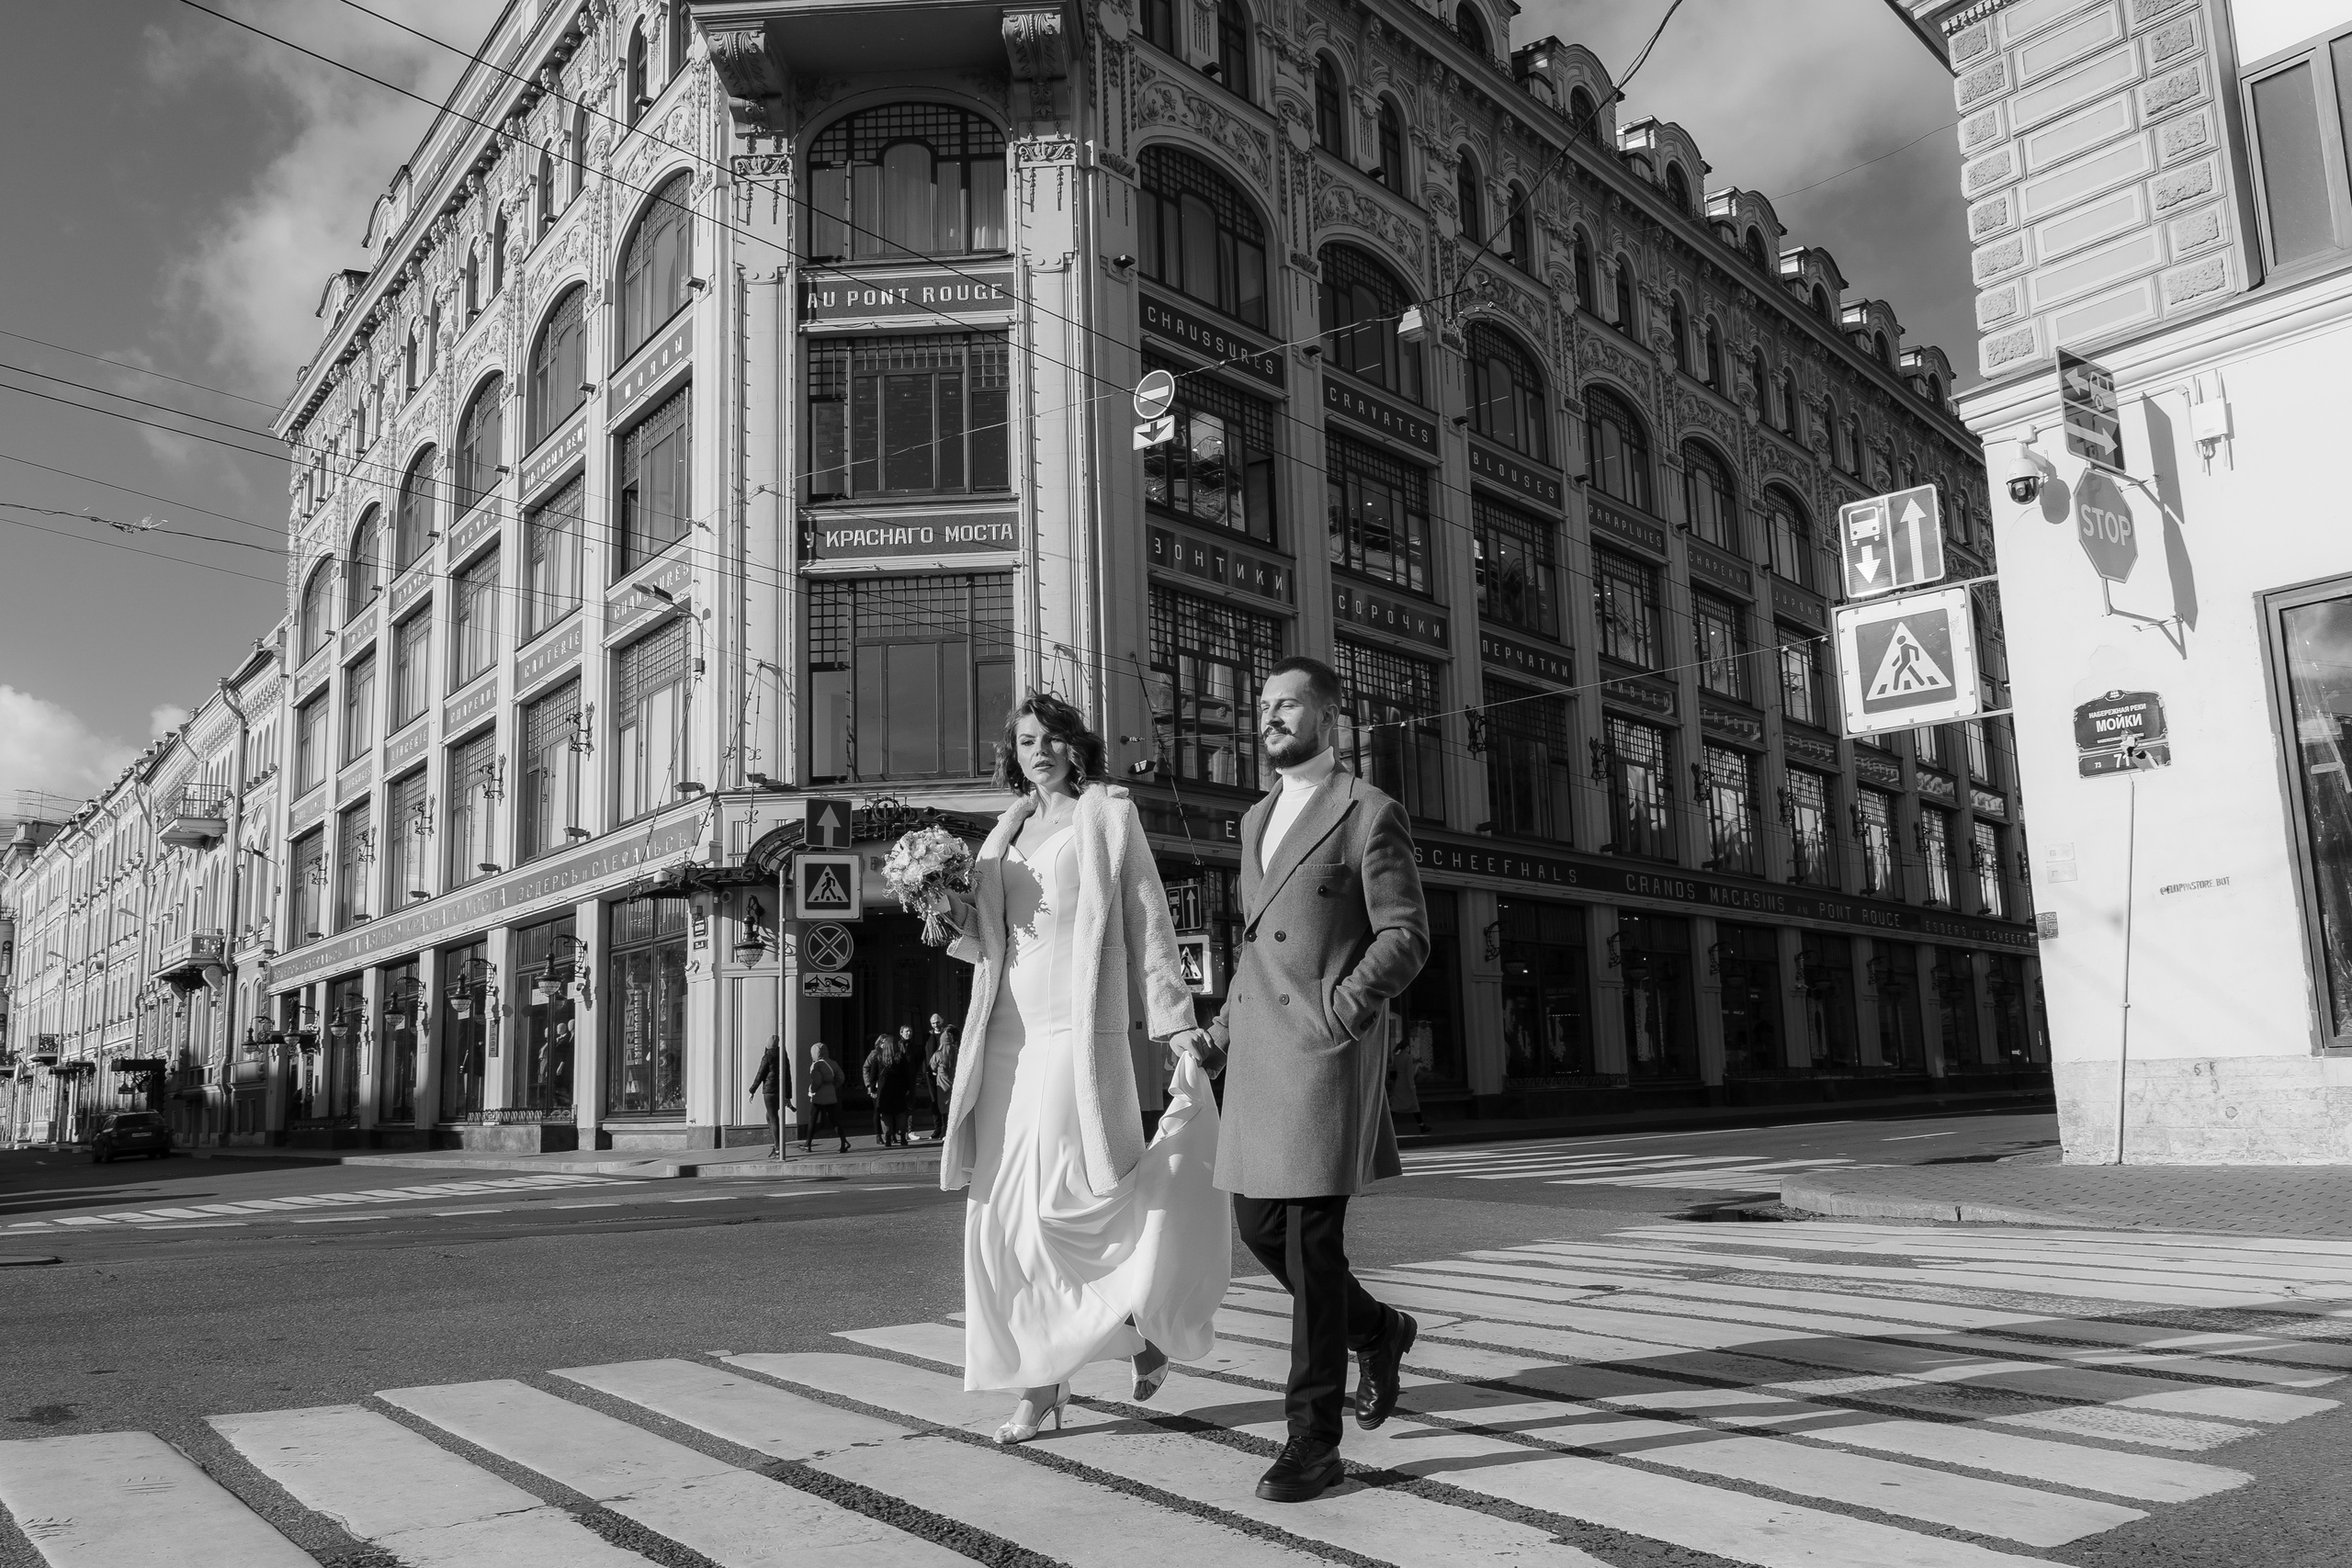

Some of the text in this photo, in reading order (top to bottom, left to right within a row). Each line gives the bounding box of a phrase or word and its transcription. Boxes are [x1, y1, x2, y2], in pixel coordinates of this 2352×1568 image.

[808, 283, 1004, 309] AU PONT ROUGE
[1148, 306, 1273, 375] CHAUSSURES
[1329, 387, 1429, 444] CRAVATES
[1473, 452, 1555, 499] BLOUSES
[826, 527, 933, 548] КРАСНАГО
[945, 523, 1013, 544] МОСТА
[2079, 503, 2132, 546] STOP
[1155, 537, 1283, 591] ЗОНТИКИ
[1339, 594, 1440, 638] СОРОЧКИ
[1482, 639, 1568, 678] ПЕРЧАТКИ
[2088, 703, 2147, 719] НАБЕРЕЖНАЯ РЕКИ
[2096, 714, 2143, 732] МОЙКИ
[2113, 753, 2130, 768] 71
[518, 869, 578, 901] ЭСДЕРСЪ
[592, 832, 687, 877] СХЕФАЛЬСЪ
[1413, 847, 1577, 884] SCHEEFHALS
[407, 905, 460, 936] КРАСНАГО
[465, 887, 506, 919] МОСТА
[1626, 874, 1695, 900] GRANDS
[1818, 902, 1851, 920] PONT
[1862, 908, 1901, 928] ROUGE
[626, 971, 635, 1066] PRISMA
